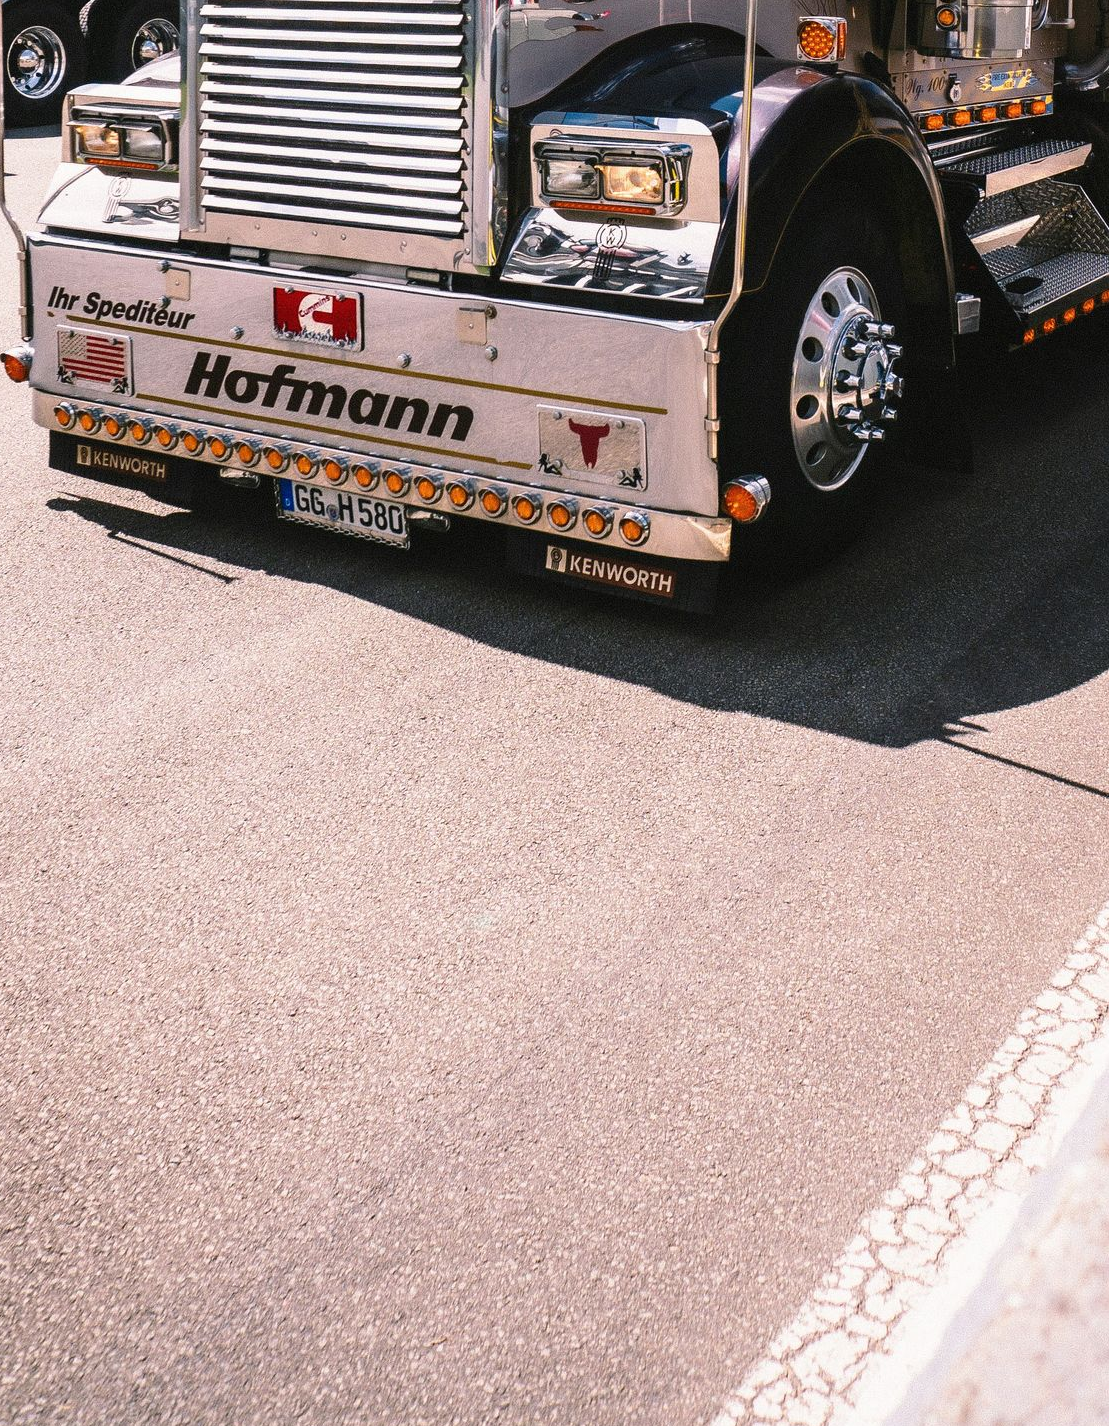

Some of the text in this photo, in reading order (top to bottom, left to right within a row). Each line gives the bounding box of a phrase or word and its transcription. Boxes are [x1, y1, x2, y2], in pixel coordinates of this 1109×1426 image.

[927, 76, 945, 92] 100
[48, 286, 196, 330] Ihr Spediteur
[298, 295, 331, 318] Cummins
[184, 351, 474, 442] Hofmann
[93, 451, 166, 478] KENWORTH
[294, 484, 404, 534] GG H 580
[569, 555, 672, 593] KENWORTH
